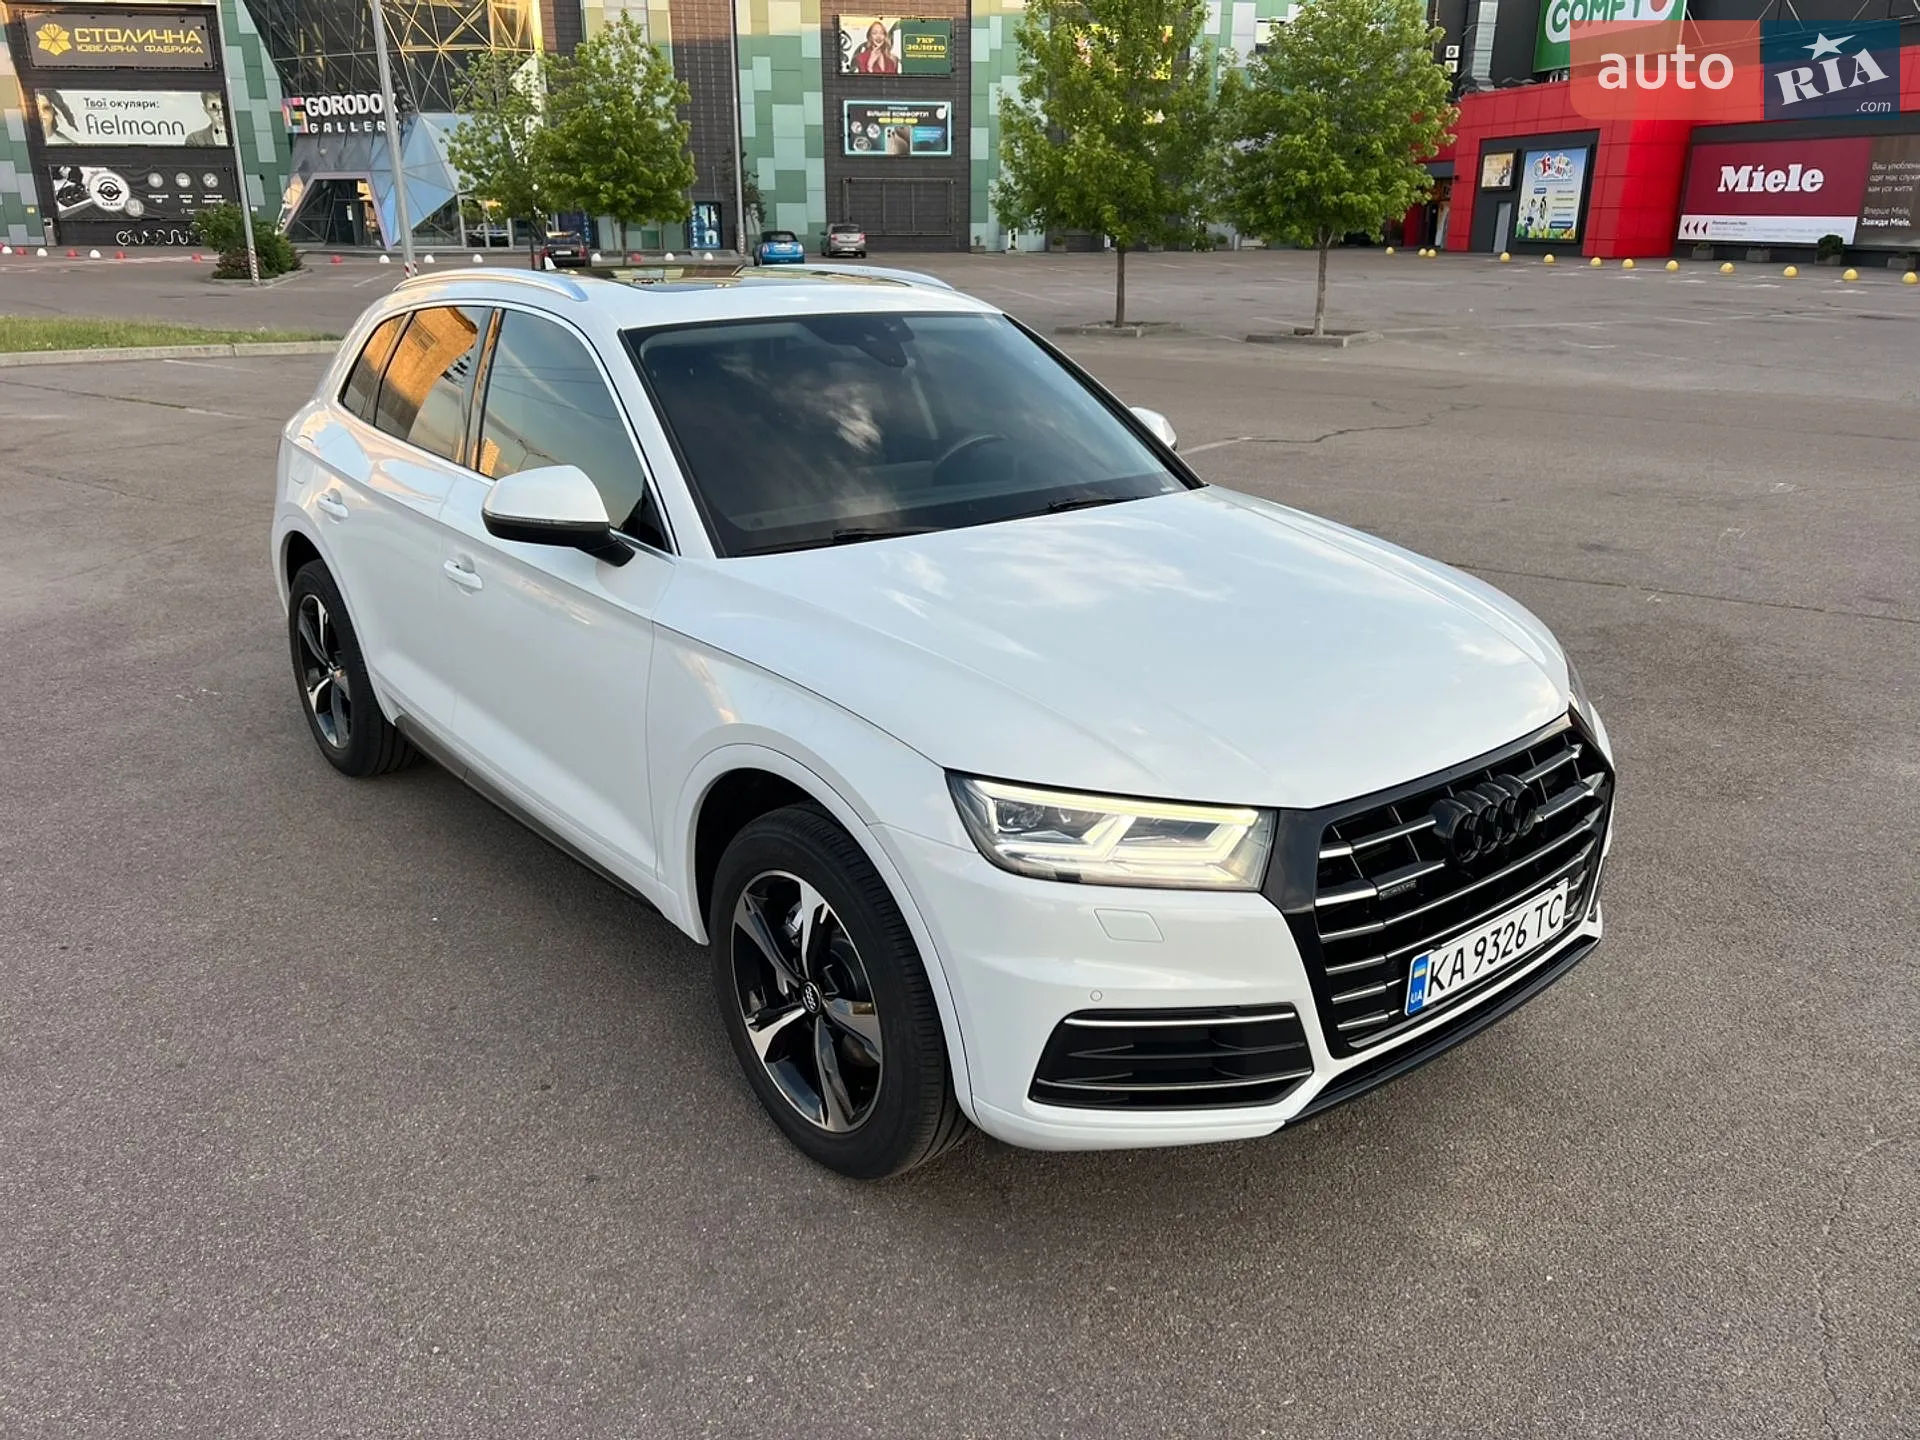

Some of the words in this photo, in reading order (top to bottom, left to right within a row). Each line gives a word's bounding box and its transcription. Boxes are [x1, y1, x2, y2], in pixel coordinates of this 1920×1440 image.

[74, 28, 202, 43] СТОЛИЧНА
[76, 44, 138, 53] ЮВЕЛІРНА
[143, 45, 204, 54] ФАБРИКА
[83, 97, 107, 108] Твої
[109, 100, 160, 111] окуляри:
[1718, 164, 1824, 193] Miele
[1427, 947, 1466, 997] KA
[1473, 912, 1528, 974] 9326
[1534, 893, 1565, 939] TC
[1411, 992, 1423, 1003] UA
